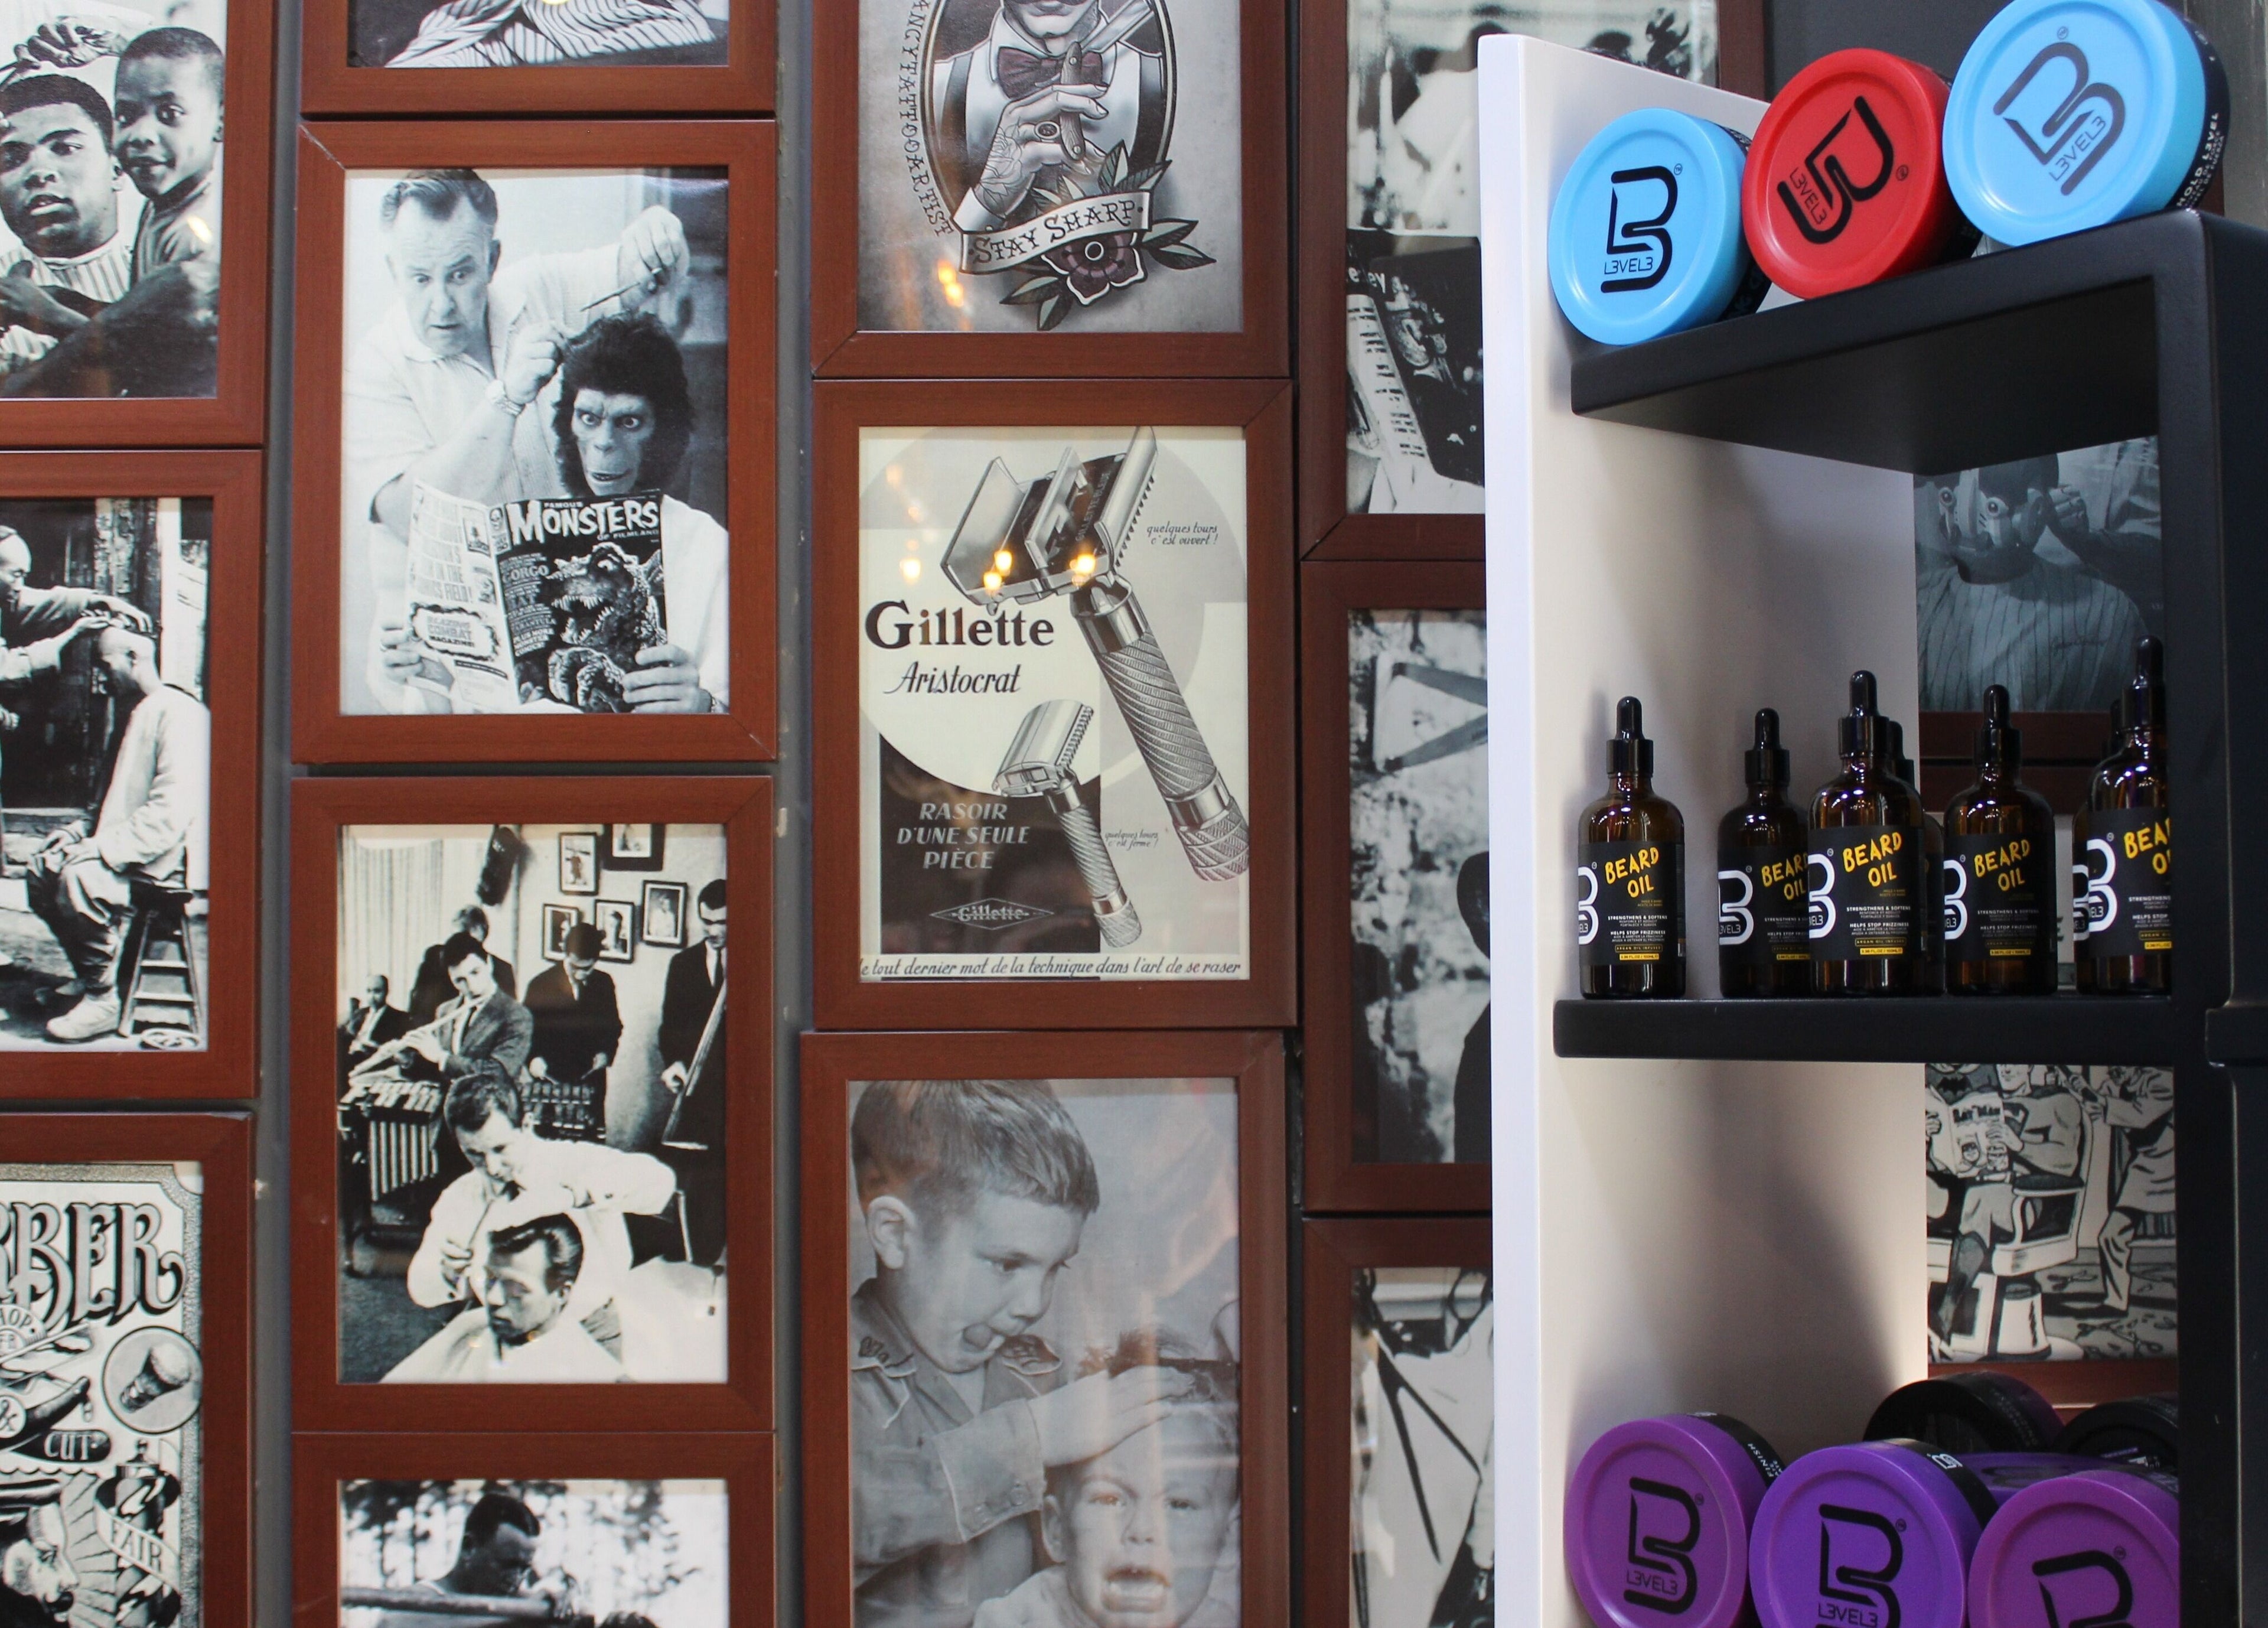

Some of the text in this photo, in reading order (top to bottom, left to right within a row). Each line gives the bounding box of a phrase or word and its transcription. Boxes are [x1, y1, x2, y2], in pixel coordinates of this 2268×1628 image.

[2048, 116, 2106, 181] L3VEL3
[1790, 167, 1827, 224] L3VEL3
[973, 199, 1135, 263] STAY SHARP
[1604, 256, 1653, 275] L3VEL3
[506, 500, 659, 546] MONSTERS
[1147, 520, 1217, 537] quelques tours
[1179, 533, 1210, 545] ouvert
[865, 600, 1054, 649] Gillette
[883, 661, 1022, 694] Aristocrat
[919, 803, 1008, 820] RASOIR
[897, 826, 1031, 845] D'UNE SEULE
[1605, 846, 1659, 884] BEARD
[1842, 832, 1902, 873] BEARD
[1974, 839, 2031, 878] BEARD
[1627, 874, 1654, 898] OIL
[1868, 861, 1897, 887] OIL
[1997, 867, 2025, 891] OIL
[1784, 878, 1806, 900] OIL
[957, 903, 1024, 922] Gillette
[872, 958, 901, 975] tout
[904, 958, 957, 975] dernier
[960, 958, 990, 975] mot
[991, 956, 1008, 974] de
[1011, 956, 1024, 973] la
[1028, 956, 1093, 977] technique
[1096, 956, 1129, 973] dans
[1133, 956, 1165, 973] l'art
[1166, 956, 1182, 973] de
[1185, 960, 1199, 973] se
[1203, 961, 1241, 973] raser
[44, 1432, 90, 1461] CUT
[110, 1515, 162, 1575] FAIR
[1627, 1569, 1678, 1596] L3VEL3
[1818, 1601, 1878, 1628] L3VEL3
